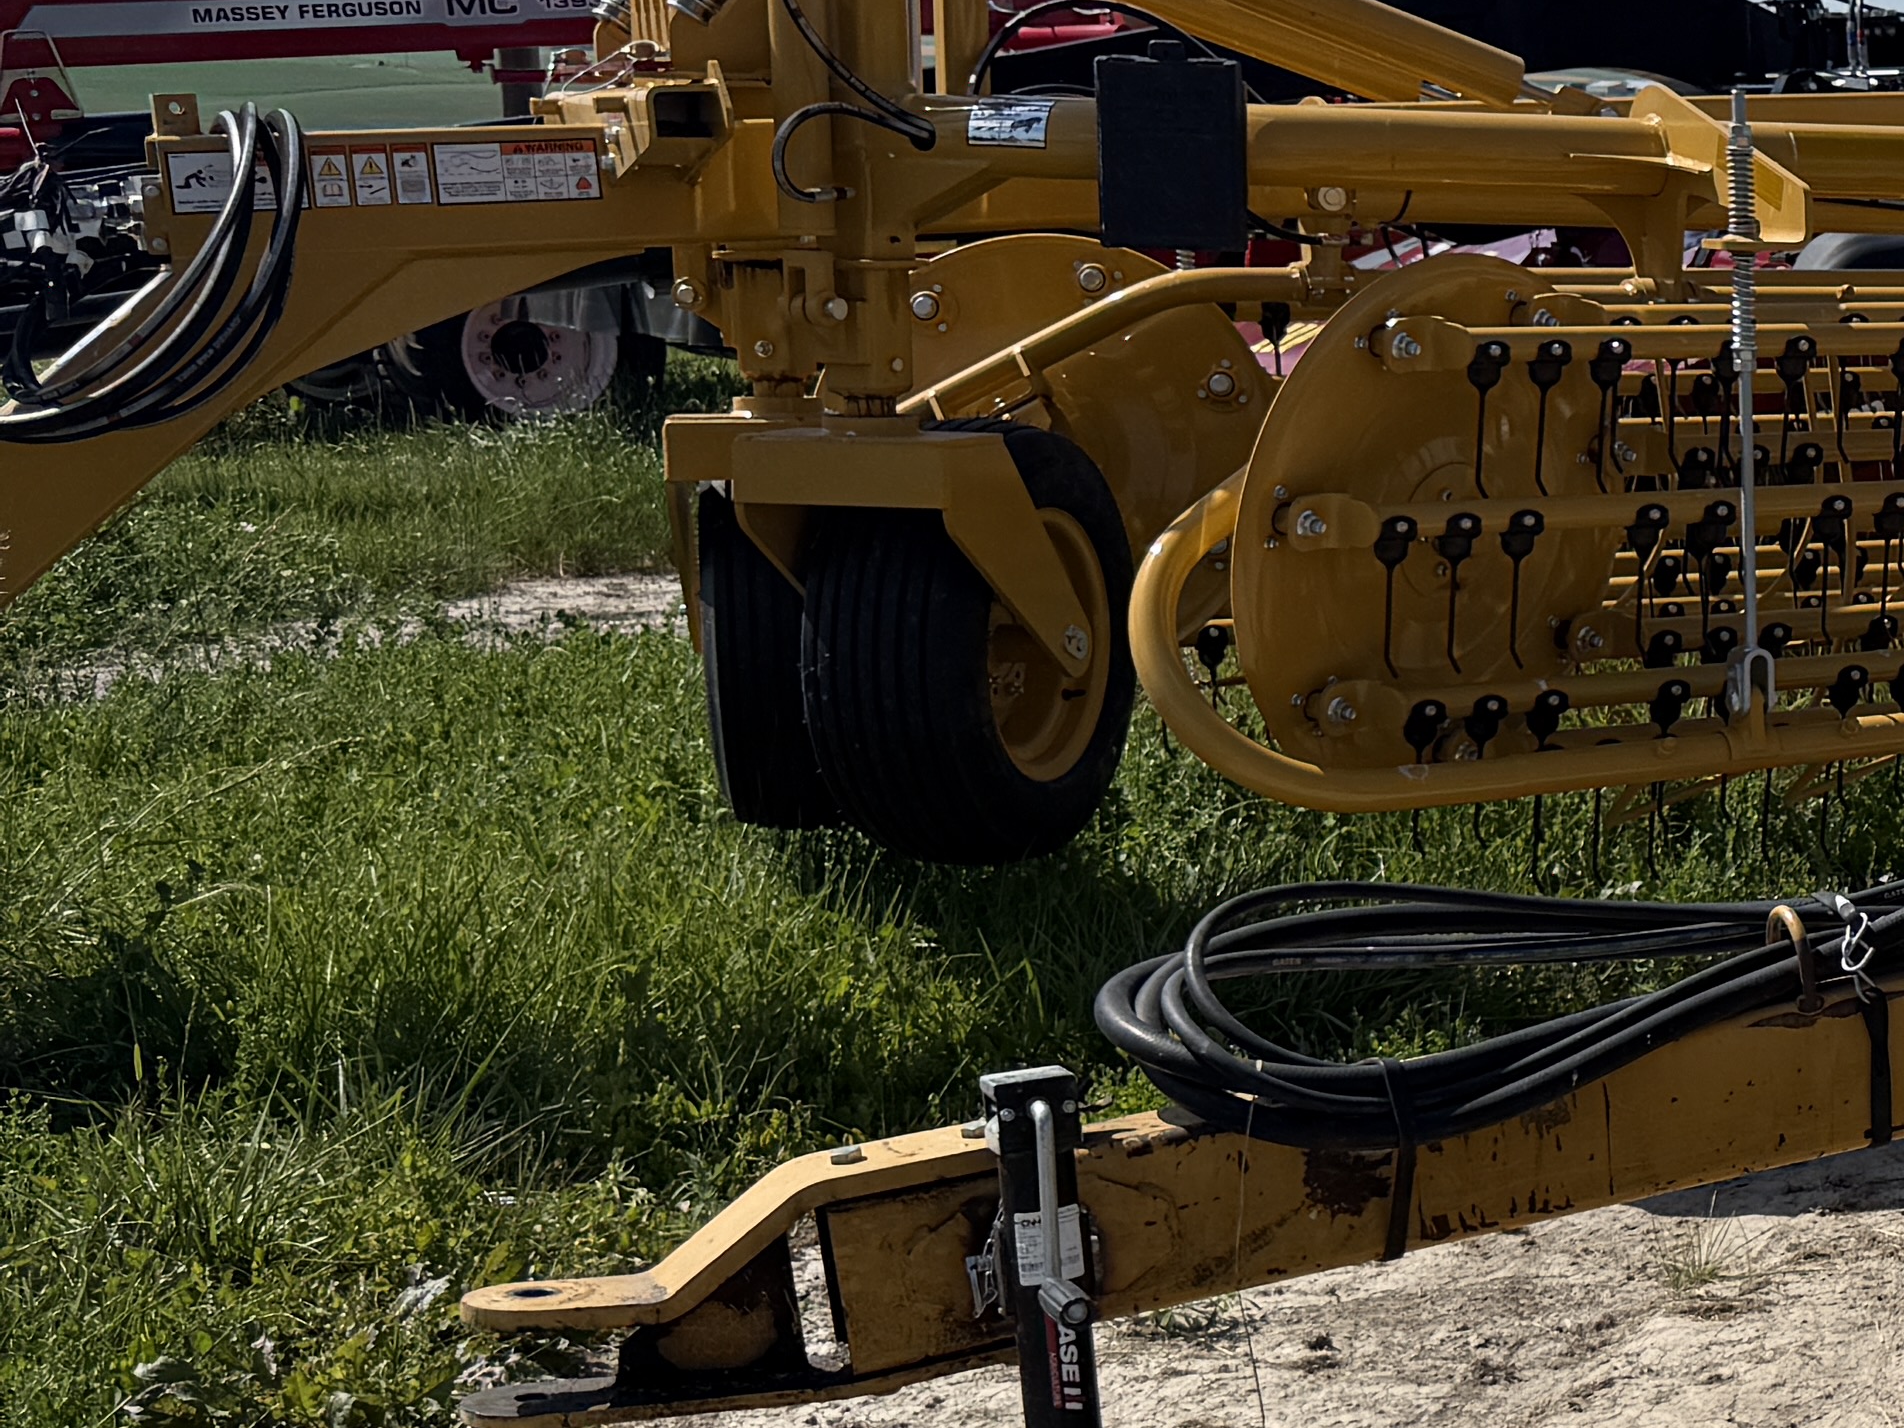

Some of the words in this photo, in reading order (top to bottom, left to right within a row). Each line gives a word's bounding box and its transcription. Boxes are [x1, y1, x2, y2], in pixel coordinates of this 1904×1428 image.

[192, 5, 289, 23] MASSEY
[299, 0, 422, 19] FERGUSON
[526, 141, 584, 153] WARNING
[1057, 1322, 1081, 1383] ASE
